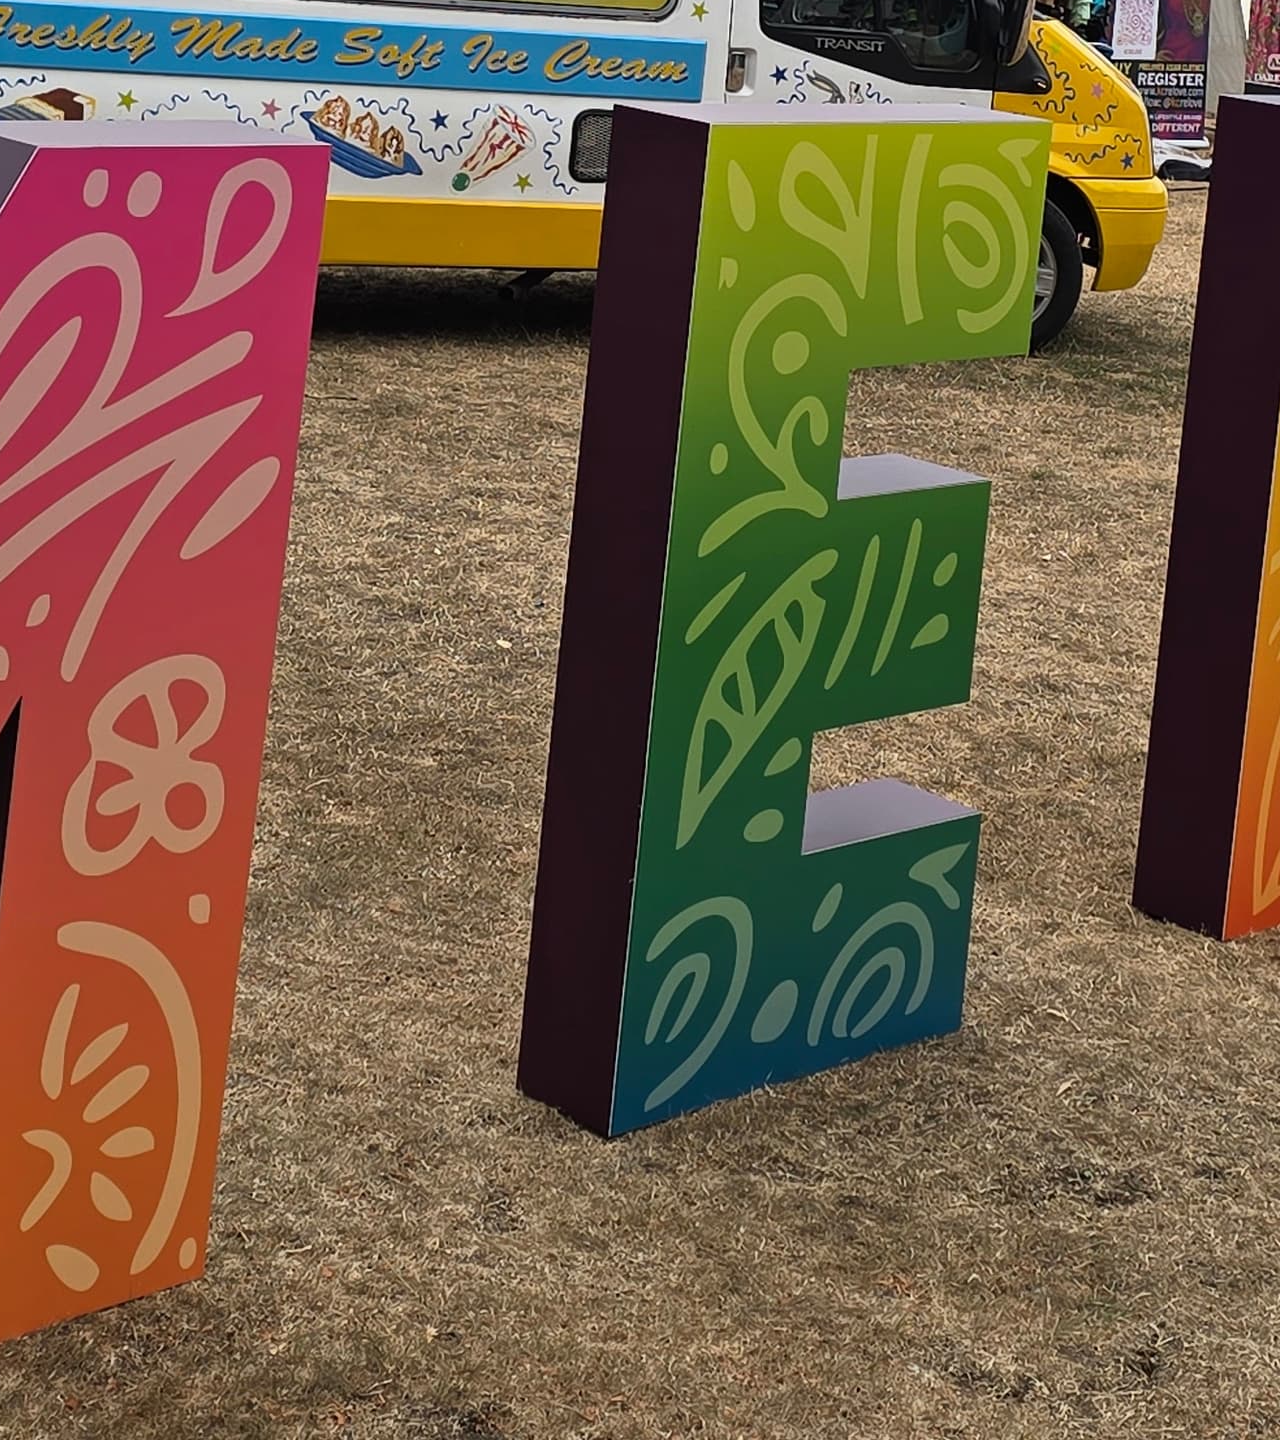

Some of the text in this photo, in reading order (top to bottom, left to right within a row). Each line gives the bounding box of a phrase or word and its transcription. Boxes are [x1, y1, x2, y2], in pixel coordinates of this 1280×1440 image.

[170, 16, 320, 64] Made
[334, 27, 445, 79] Soft
[462, 34, 528, 76] Ice
[544, 40, 689, 84] Cream
[815, 37, 886, 53] TRANSIT
[1137, 72, 1204, 86] REGISTER
[1151, 123, 1200, 133] DIFFERENT
